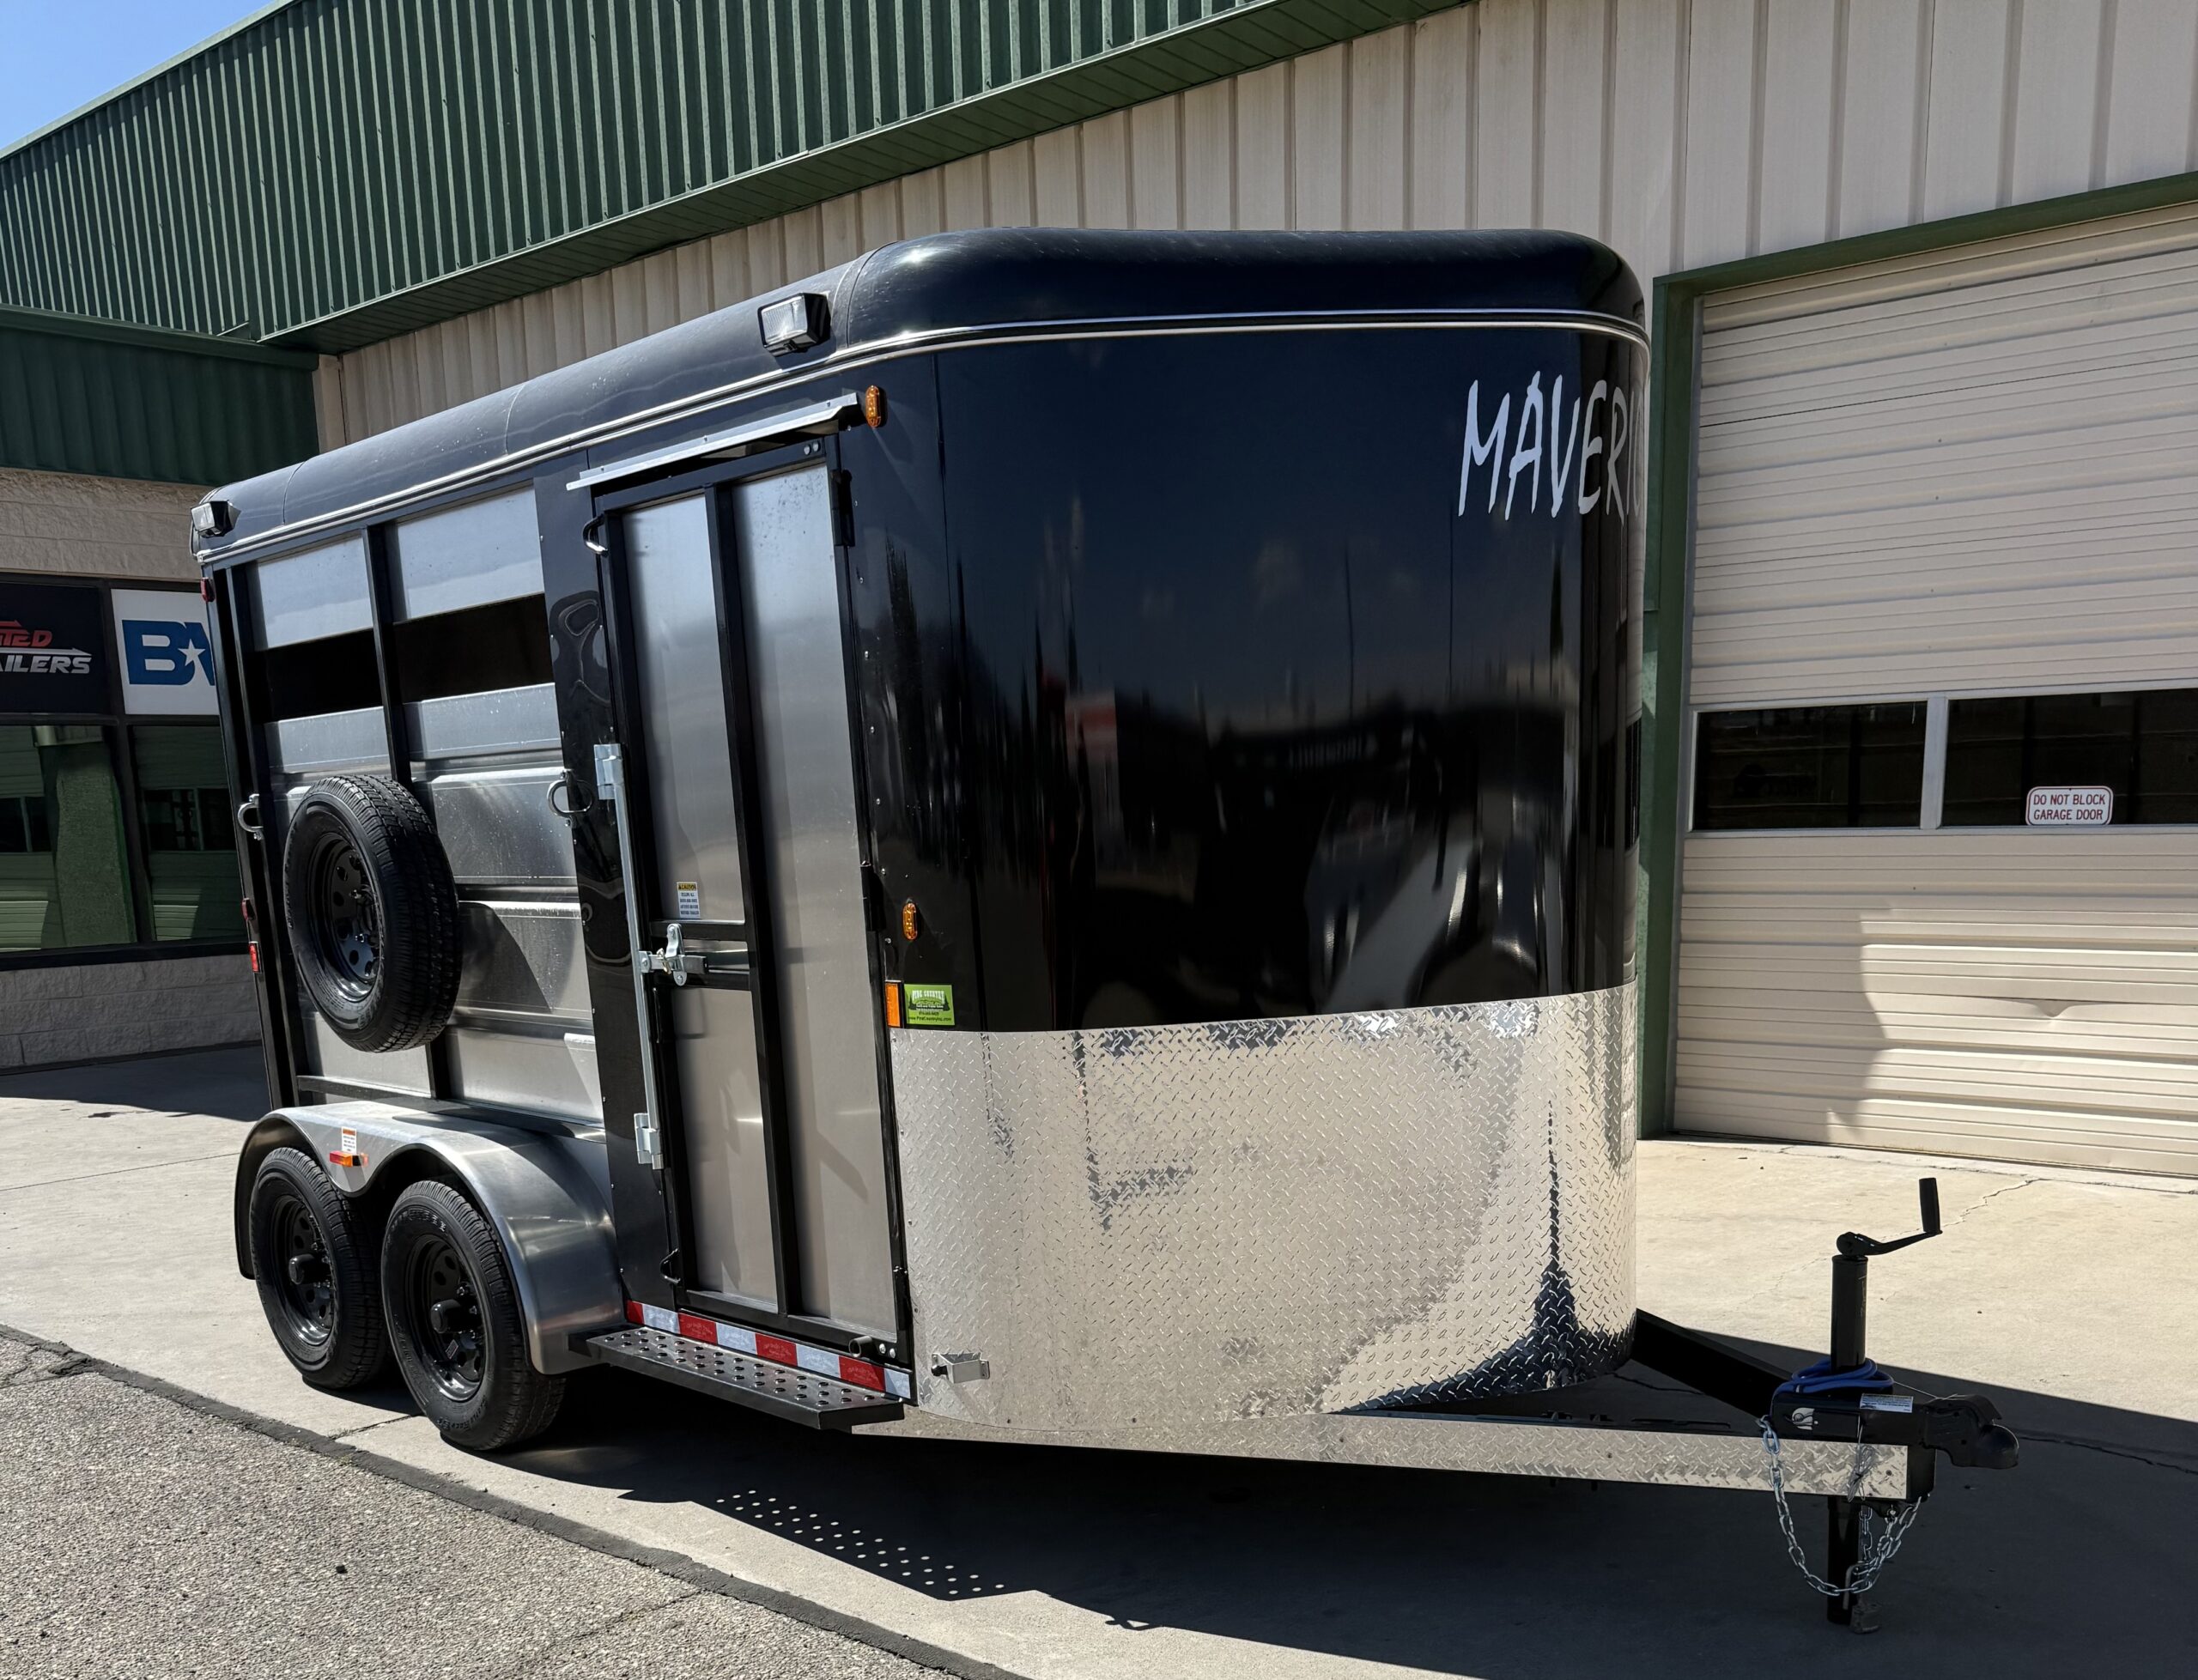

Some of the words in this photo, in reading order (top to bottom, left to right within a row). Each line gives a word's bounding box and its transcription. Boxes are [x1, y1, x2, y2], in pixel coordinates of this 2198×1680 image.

[2033, 794, 2047, 805] DO
[2050, 794, 2070, 805] NOT
[2073, 794, 2106, 805] BLOCK
[2033, 810, 2072, 821] GARAGE
[2076, 810, 2104, 820] DOOR
